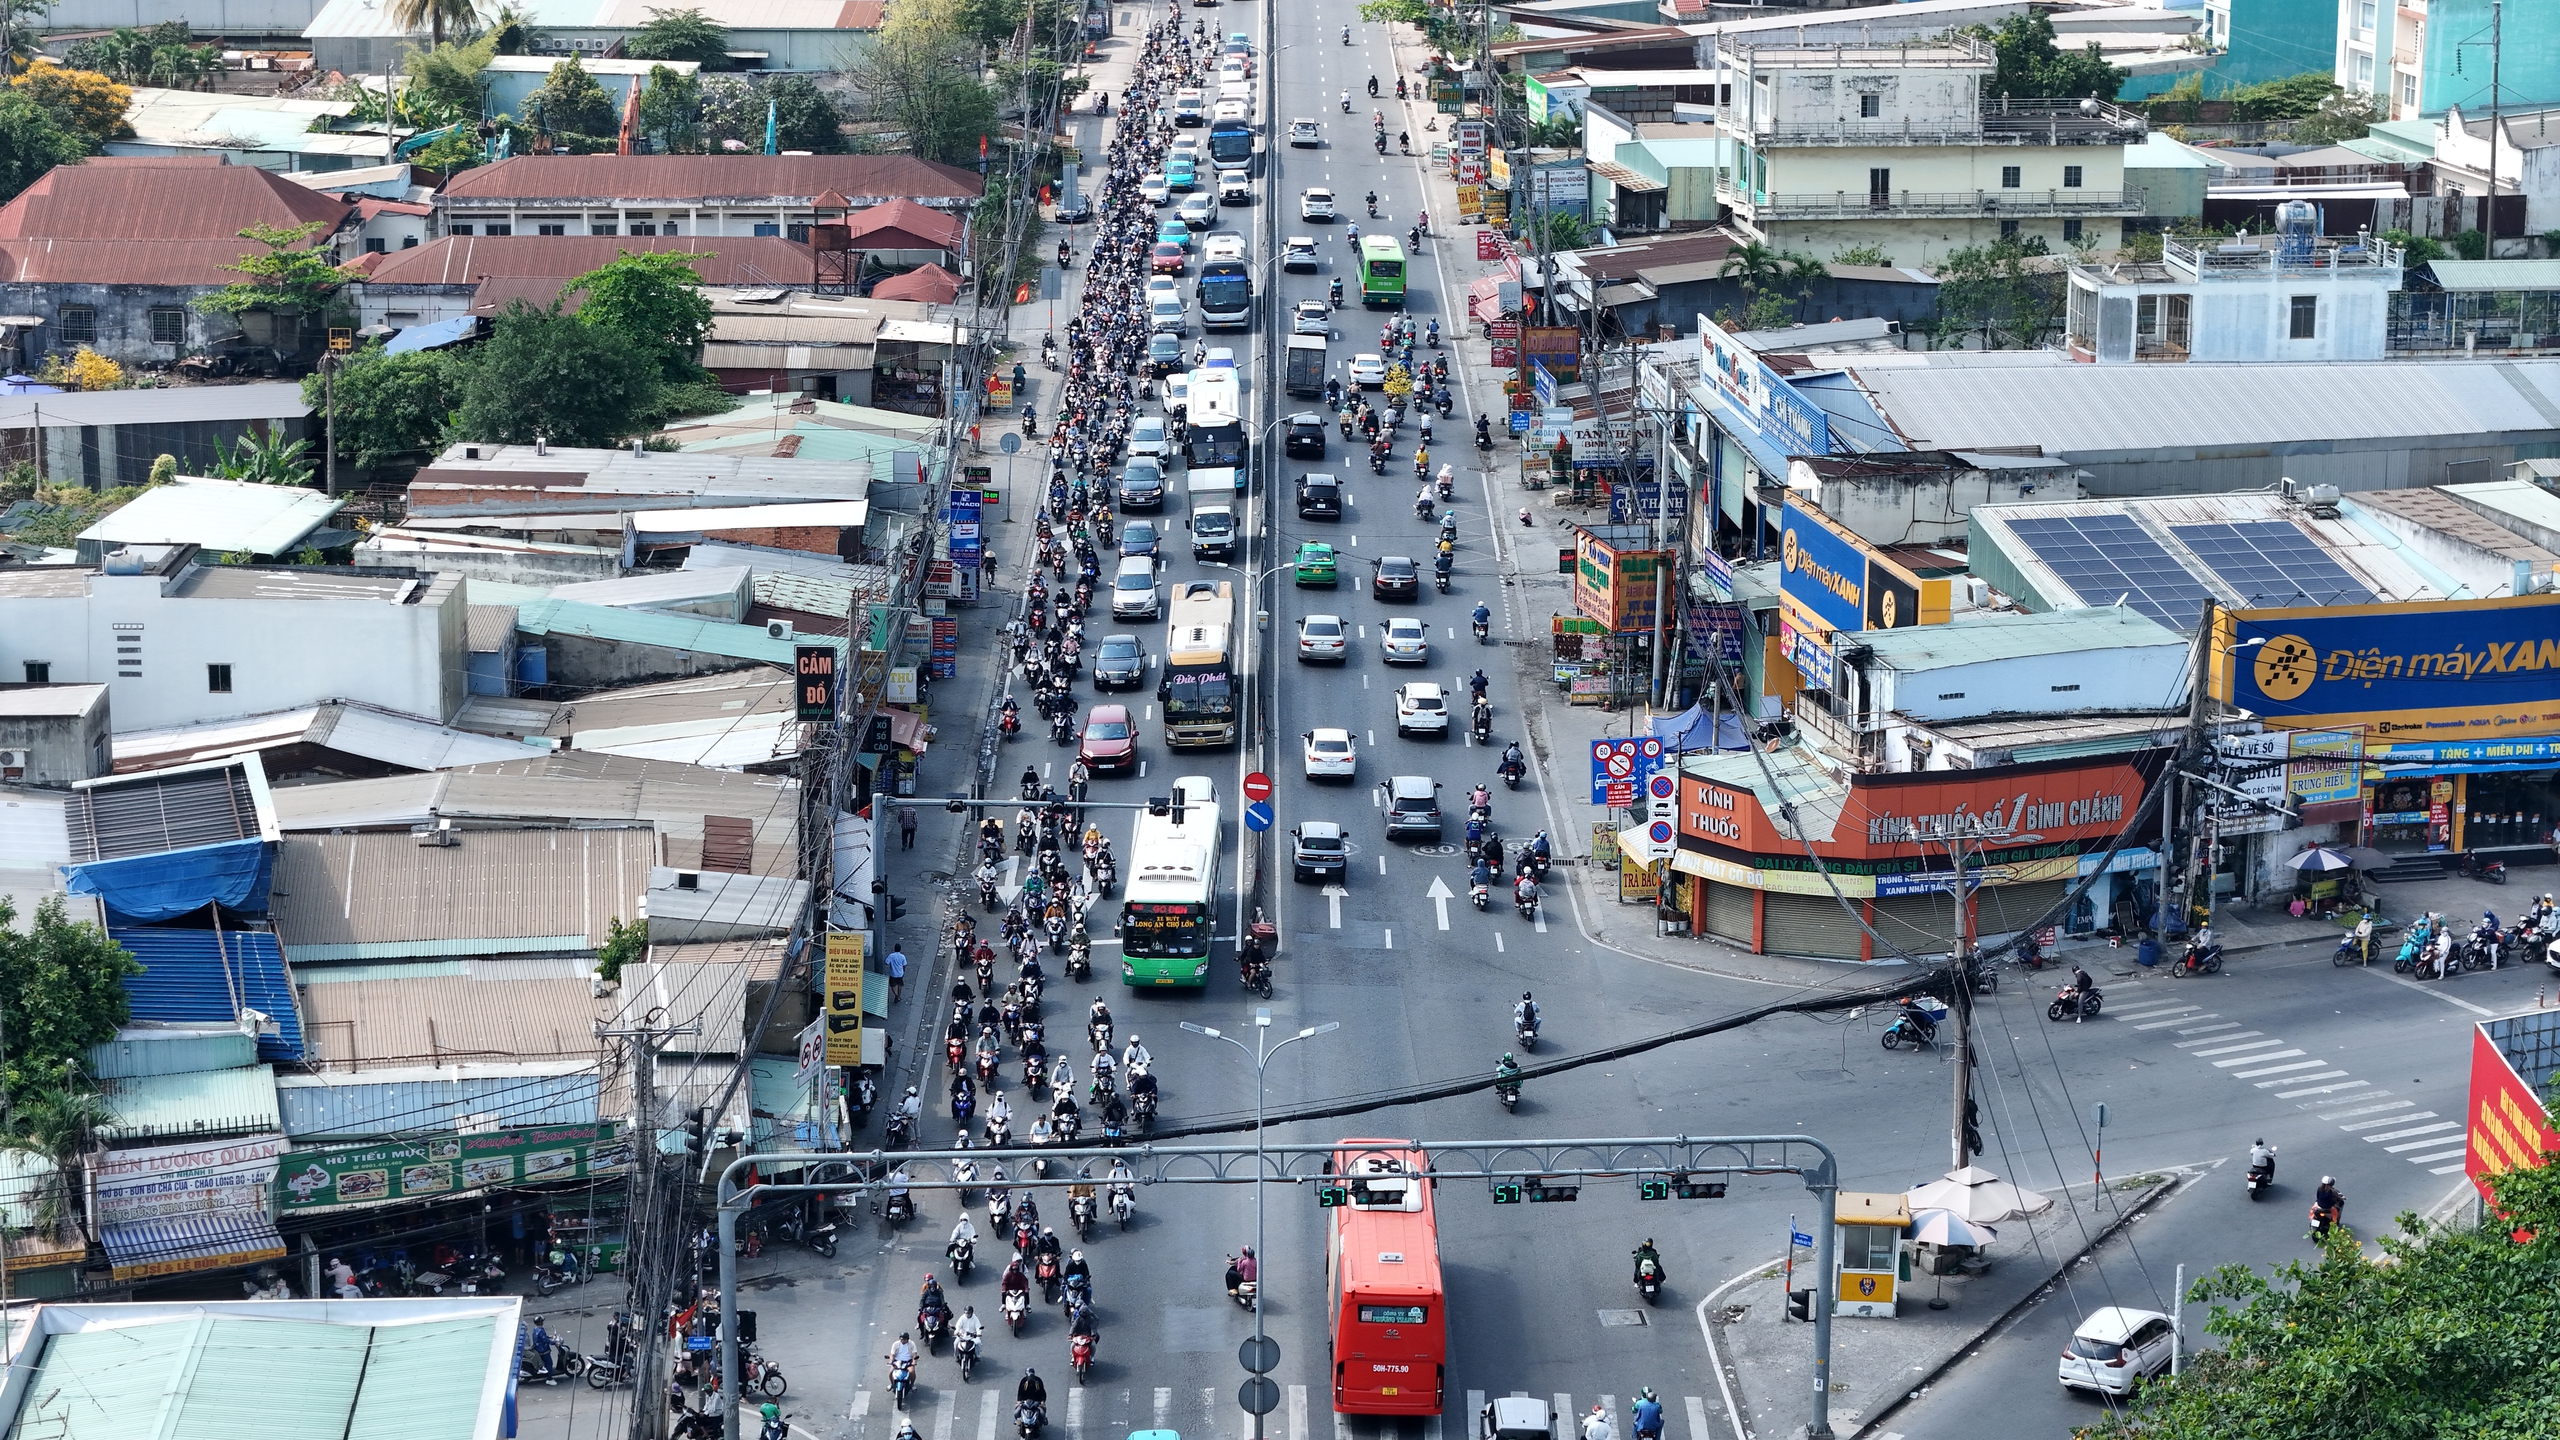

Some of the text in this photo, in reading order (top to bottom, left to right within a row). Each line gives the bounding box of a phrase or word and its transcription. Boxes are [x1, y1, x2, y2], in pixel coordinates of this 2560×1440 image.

[1464, 129, 1481, 137] NHÀ
[1798, 548, 1816, 579] Điện
[1564, 619, 1577, 632] HEO
[800, 651, 832, 675] CẦM
[2322, 647, 2403, 688] Điện
[890, 670, 914, 683] THÚ
[1173, 672, 1227, 685] Đức Phát
[806, 681, 826, 704] ĐỒ
[897, 685, 906, 695] Y
[876, 719, 887, 729] XỔ
[2426, 719, 2466, 729] Panasonic
[876, 730, 887, 740] SỐ
[873, 742, 889, 751] CÀO
[1600, 747, 1608, 756] 60
[1649, 743, 1657, 752] 60
[2249, 737, 2275, 754] VÉ SỐ
[2440, 746, 2469, 759] TẶNG
[2252, 784, 2282, 795] CÁC TỈNH
[2292, 777, 2321, 791] TRUNG
[1698, 785, 1734, 811] KÍNH
[1869, 811, 1912, 844] KÍNH
[1982, 798, 2005, 831] SỐ
[2006, 792, 2028, 832] 1
[2026, 798, 2065, 830] BÌNH
[2069, 791, 2123, 826] CHÁNH
[1690, 812, 1740, 840] THUỐC
[2011, 848, 2030, 861] GIA
[2034, 844, 2063, 860] KÍNH
[2064, 842, 2080, 858] ĐỘ
[1755, 857, 1780, 871] ĐẠI
[1783, 857, 1798, 870] LÝ
[1877, 859, 1901, 874] GIÁ
[1624, 869, 1639, 887] TRÀ
[1728, 866, 1743, 883] CÓ
[1746, 870, 1763, 889] ĐỘ
[1765, 883, 1874, 897] CAO 100K
[1886, 884, 1928, 895] XANH NHẬT
[1166, 921, 1180, 929] CHỢ
[1181, 919, 1194, 928] LỚN
[352, 1150, 386, 1163] TIẾU
[392, 1147, 425, 1159] MỰC
[174, 1181, 188, 1191] CUA
[1643, 1182, 1666, 1200] 57
[1322, 1188, 1345, 1206] 57
[1496, 1185, 1519, 1203] 57
[164, 1264, 172, 1272] &
[1373, 1364, 1409, 1373] 50H-775.90
